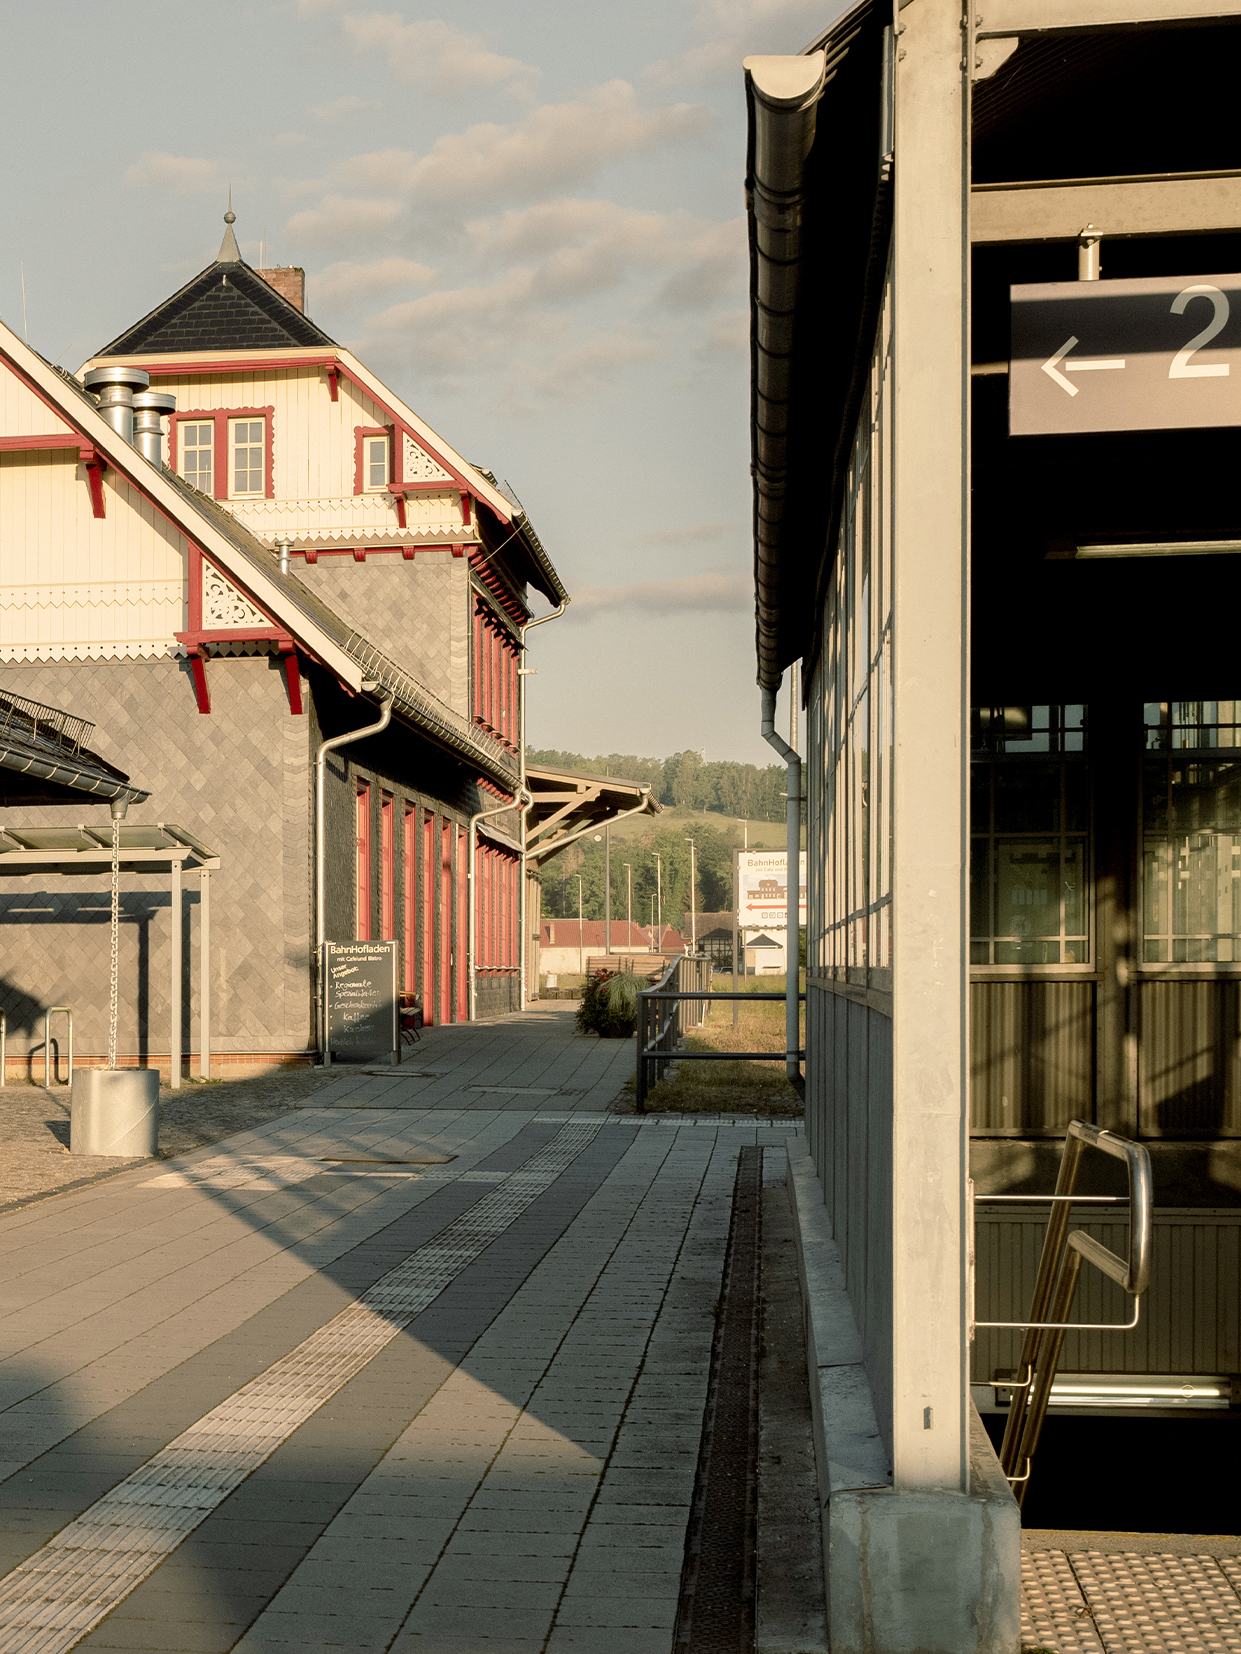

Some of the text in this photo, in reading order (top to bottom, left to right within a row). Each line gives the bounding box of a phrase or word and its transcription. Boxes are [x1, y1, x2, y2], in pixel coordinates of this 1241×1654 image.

[1168, 284, 1230, 379] 2
[330, 944, 391, 955] BahnHofladen
[330, 964, 346, 974] Unser
[335, 979, 372, 991] Regionale
[343, 1012, 371, 1022] Kaffee
